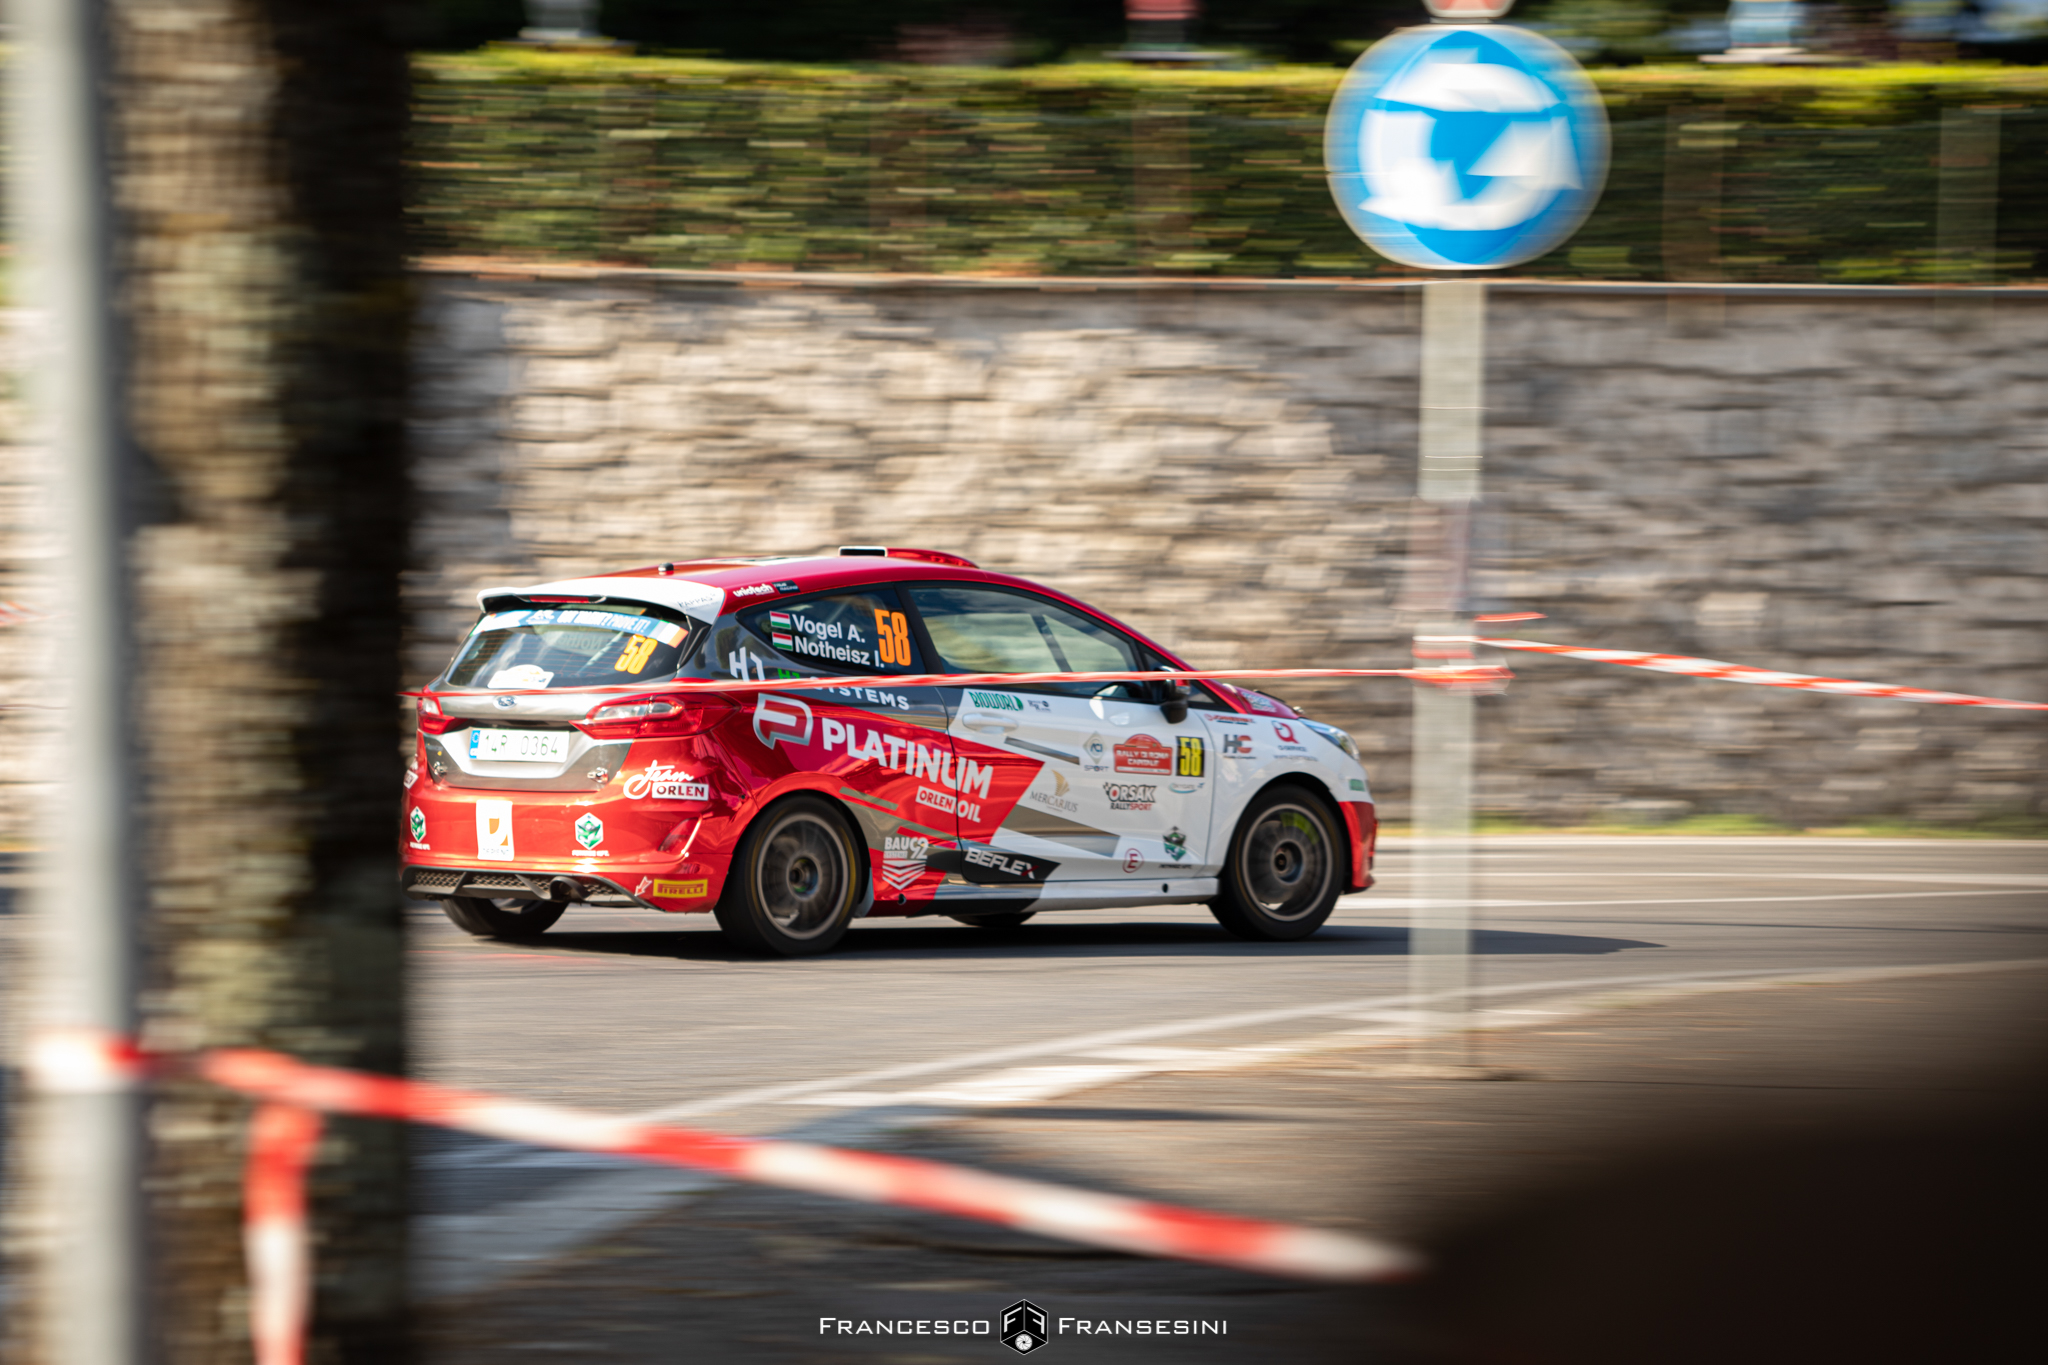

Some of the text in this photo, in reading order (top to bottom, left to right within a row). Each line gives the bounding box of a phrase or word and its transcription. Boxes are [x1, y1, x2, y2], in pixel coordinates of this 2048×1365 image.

[792, 613, 866, 644] Vogel A.
[873, 608, 912, 667] 58
[614, 633, 659, 675] 58
[795, 635, 885, 669] Notheisz I.
[521, 735, 558, 757] 0364
[822, 717, 994, 800] PLATINUM
[1116, 749, 1139, 758] RALLY
[1179, 737, 1202, 777] 58
[656, 785, 705, 798] ORLEN
[919, 789, 981, 823] ORLEN OIL
[1029, 790, 1078, 812] MERCARIUS
[1107, 784, 1157, 803] ORSAK
[1110, 802, 1153, 811] RALLYSPORT
[965, 847, 1040, 880] BEFLEX
[658, 882, 704, 895] PIRELLI
